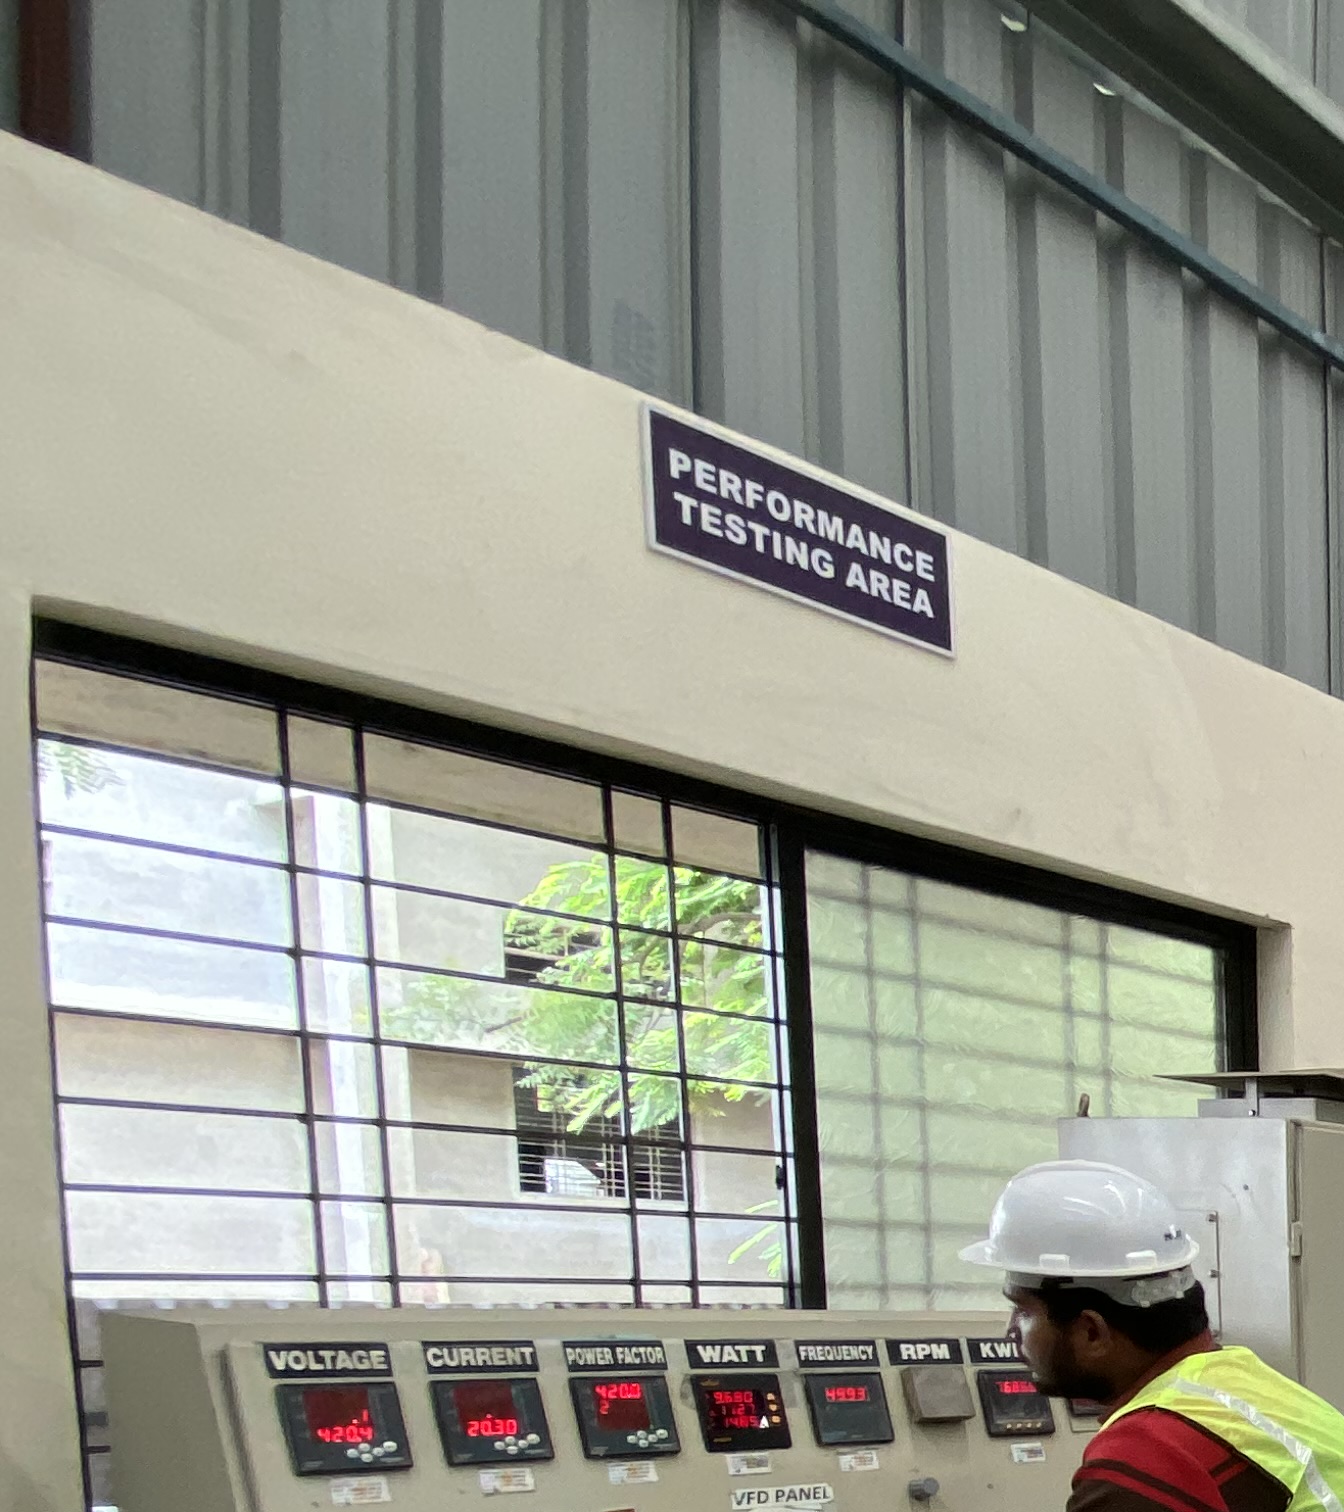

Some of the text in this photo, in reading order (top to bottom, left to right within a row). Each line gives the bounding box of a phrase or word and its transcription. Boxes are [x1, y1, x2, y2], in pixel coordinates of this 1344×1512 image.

[668, 448, 936, 582] PERFORMANCE
[673, 491, 935, 619] TESTING AREA
[268, 1350, 389, 1371] VOLTAGE
[426, 1346, 534, 1367] CURRENT
[566, 1346, 666, 1365] POWER FACTOR
[697, 1345, 767, 1363] WATT
[799, 1344, 874, 1362] FREQUENCY
[899, 1343, 951, 1360] RPM
[733, 1486, 831, 1506] VFD PANEL
